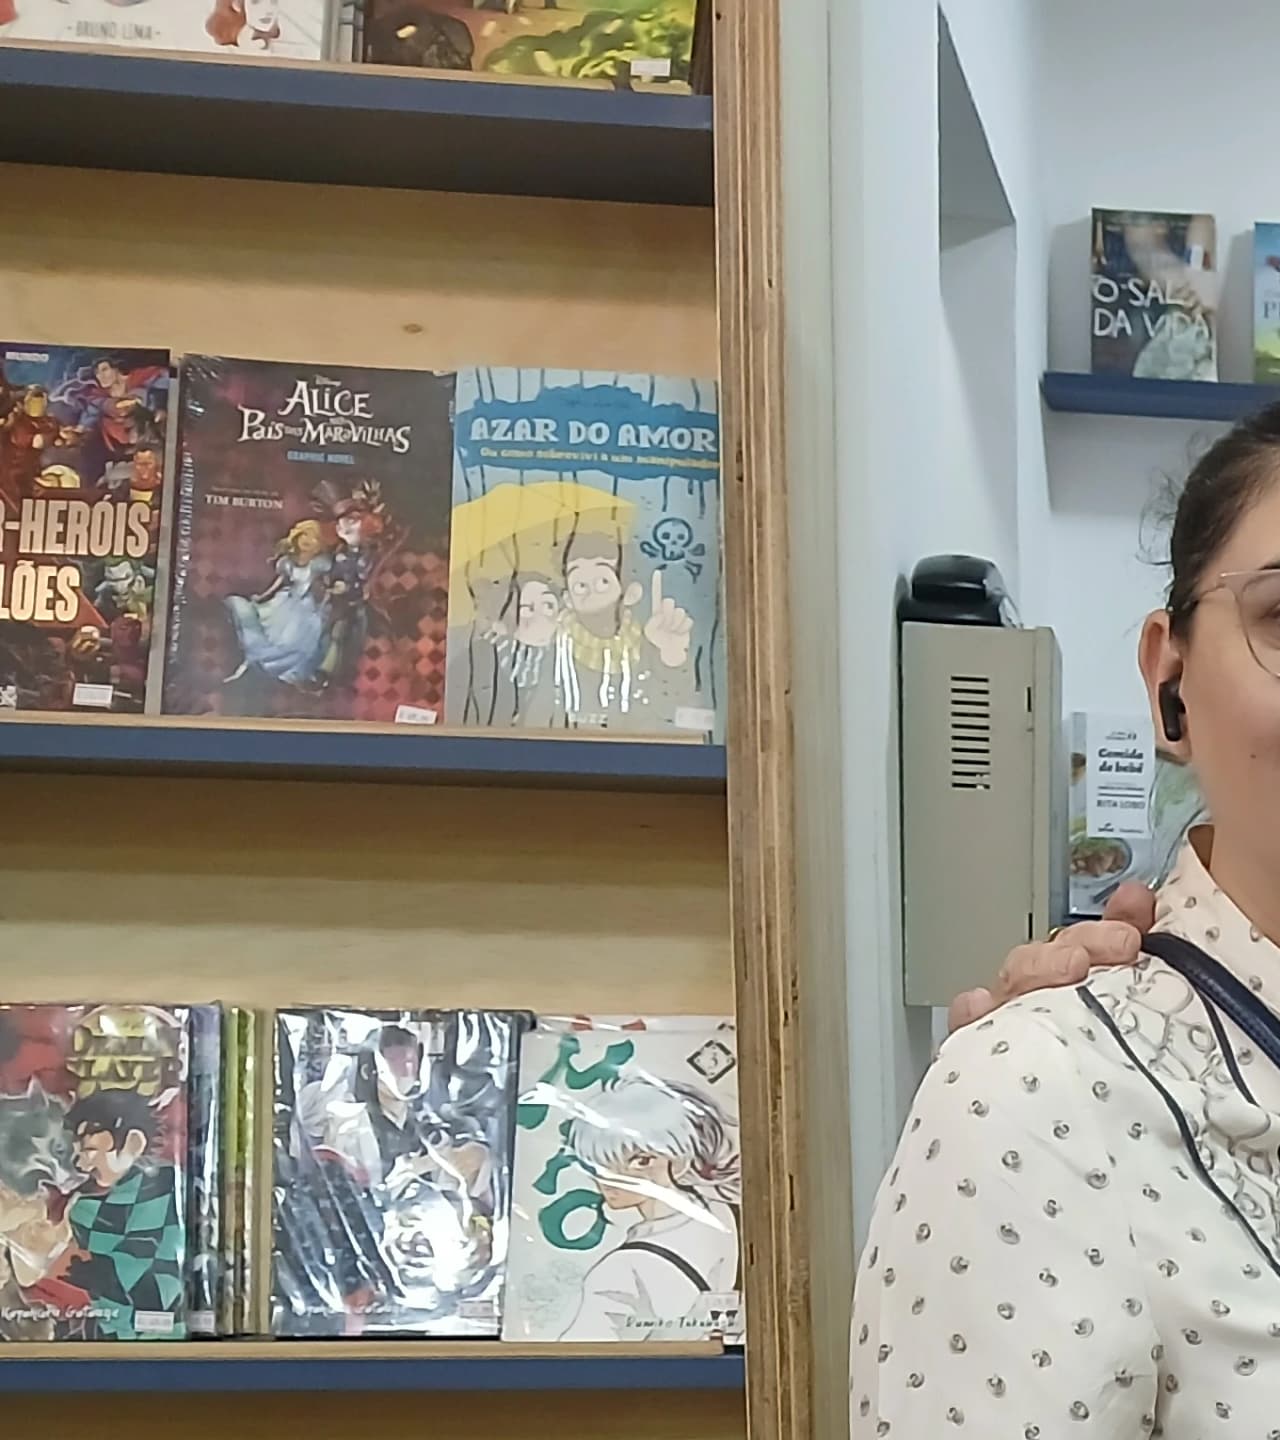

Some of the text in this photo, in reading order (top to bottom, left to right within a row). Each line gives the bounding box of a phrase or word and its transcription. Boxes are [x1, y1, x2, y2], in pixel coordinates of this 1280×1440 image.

[1094, 307, 1133, 338] DA
[470, 417, 719, 452] AZAR DO AMOR
[205, 494, 284, 510] TIM BURTON
